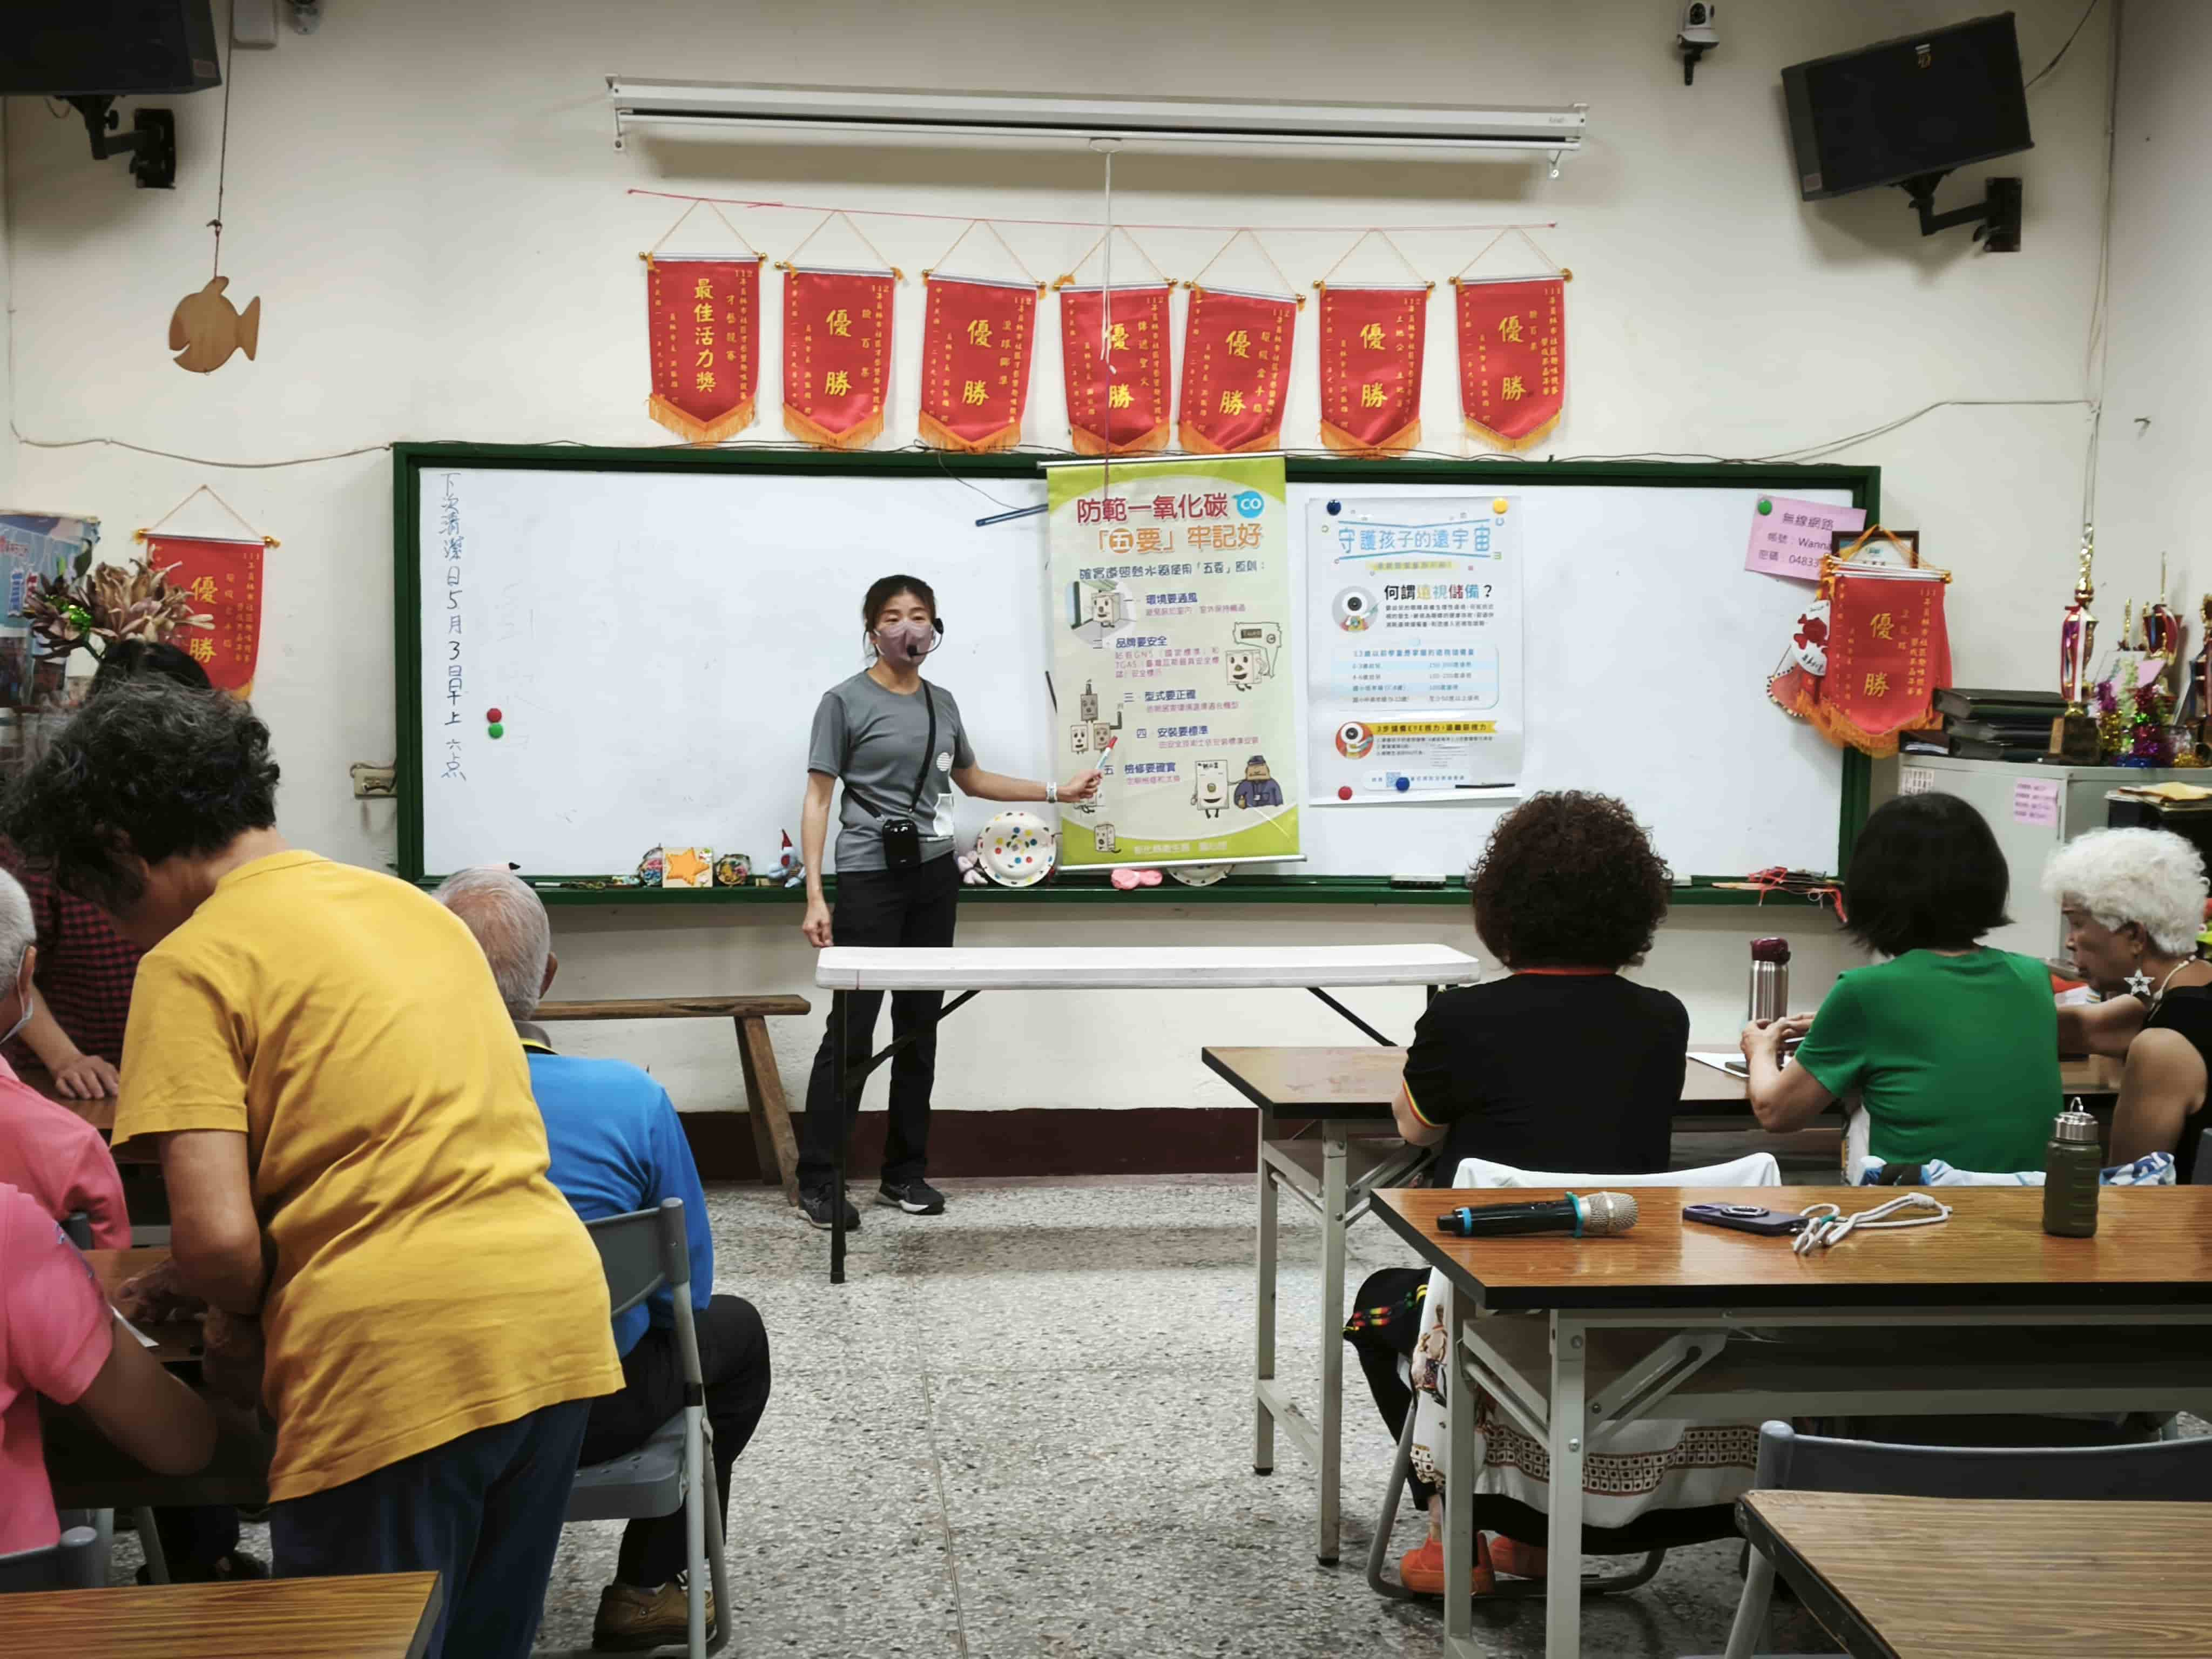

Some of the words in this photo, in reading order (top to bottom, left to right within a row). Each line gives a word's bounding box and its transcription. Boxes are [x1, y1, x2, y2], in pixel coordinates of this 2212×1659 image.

[694, 278, 716, 393] 最佳活力獎
[825, 309, 852, 397] 優勝
[962, 319, 993, 406] 優勝
[1105, 323, 1134, 409] 優勝
[1219, 329, 1251, 416] 優勝
[1360, 322, 1388, 408] 優勝
[1499, 315, 1527, 401] 優勝
[1077, 492, 1229, 524] 防範一氧化碳
[1240, 497, 1262, 510] CO
[1339, 524, 1491, 554] 守護孩子的遠宇宙
[1783, 512, 1833, 531] 無線網路
[190, 576, 218, 663] 優勝
[1864, 612, 1894, 697] 優勝
